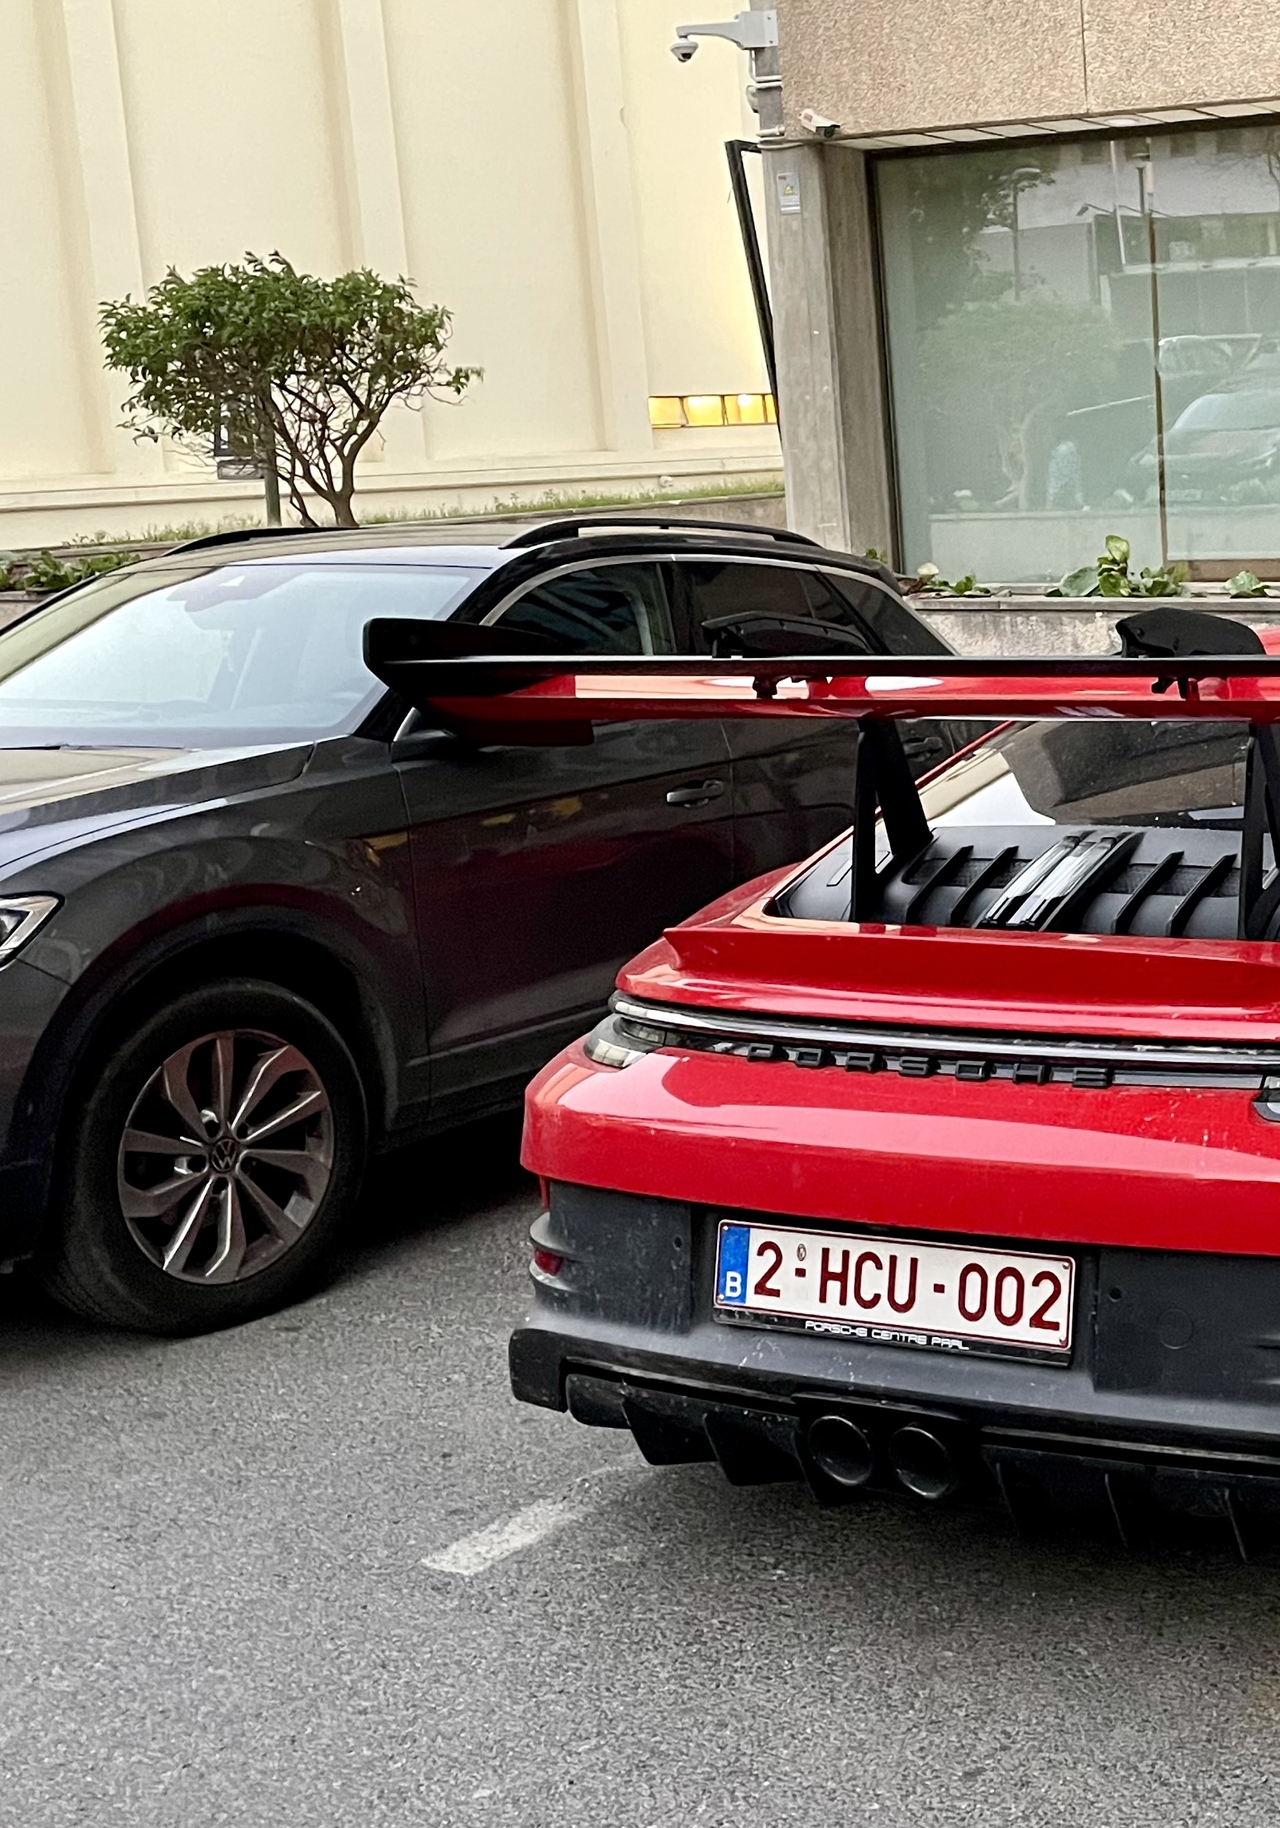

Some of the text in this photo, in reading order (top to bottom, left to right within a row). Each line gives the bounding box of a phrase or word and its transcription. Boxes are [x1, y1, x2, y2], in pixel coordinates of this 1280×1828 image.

[747, 1043, 1108, 1088] PORSCHE
[725, 1271, 742, 1299] B
[805, 1320, 867, 1338] PORSCHE
[871, 1329, 928, 1346] CENTRE
